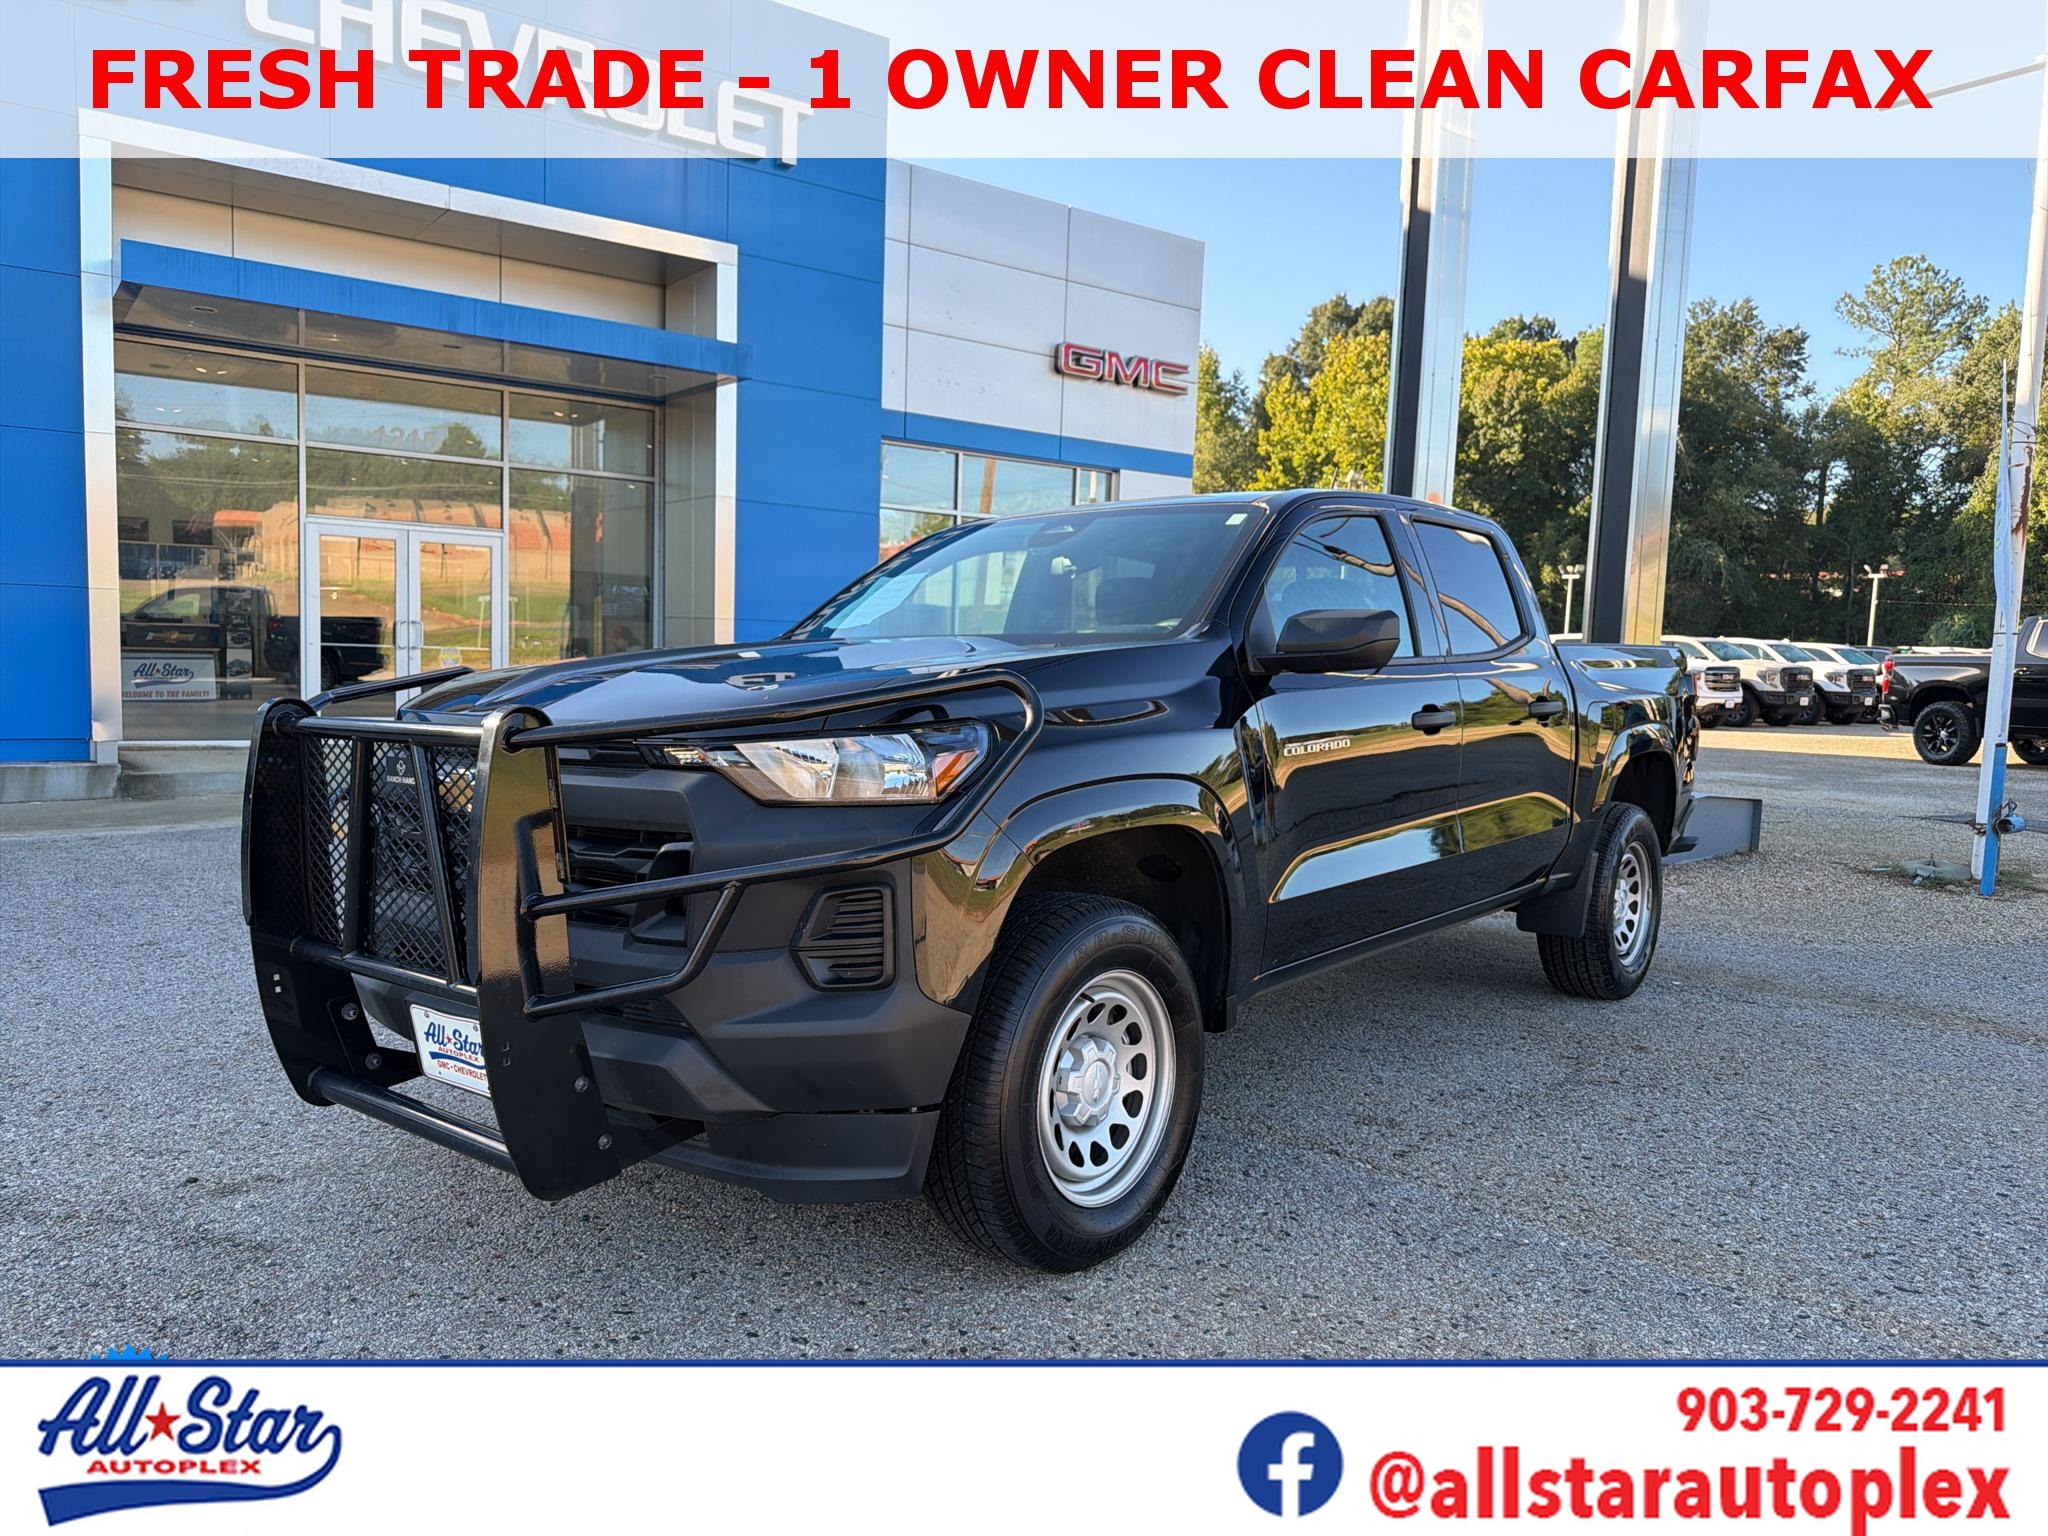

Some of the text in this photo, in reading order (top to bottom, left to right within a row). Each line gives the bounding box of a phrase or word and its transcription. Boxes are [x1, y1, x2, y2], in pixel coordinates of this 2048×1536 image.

[1055, 342, 1189, 395] GMC
[1283, 738, 1351, 757] COLORADO
[424, 1021, 448, 1047] All
[438, 1047, 480, 1063] AUTOPLEX
